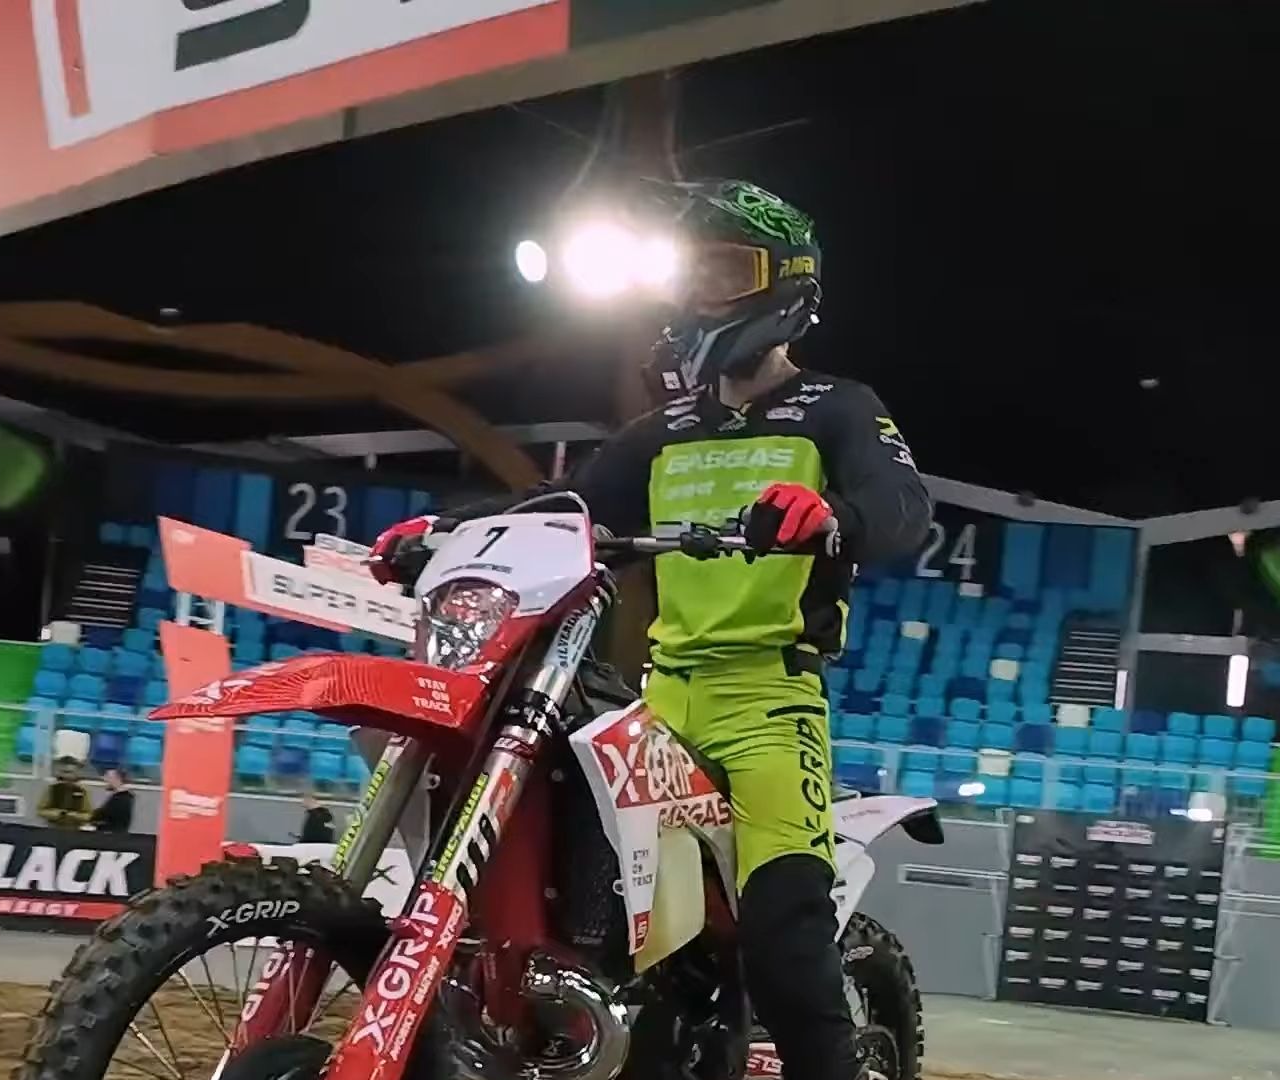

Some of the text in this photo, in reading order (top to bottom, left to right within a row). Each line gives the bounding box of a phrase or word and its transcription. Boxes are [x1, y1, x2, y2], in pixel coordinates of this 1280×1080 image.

[665, 448, 795, 476] GASGAS
[285, 483, 347, 540] 23
[474, 525, 510, 559] 7
[916, 522, 976, 581] 24
[272, 573, 357, 609] SUPER
[601, 732, 696, 803] X-GRIP
[795, 717, 834, 859] X-GRIP
[206, 900, 301, 938] X-GRIP
[352, 891, 440, 1055] X-GRIP
